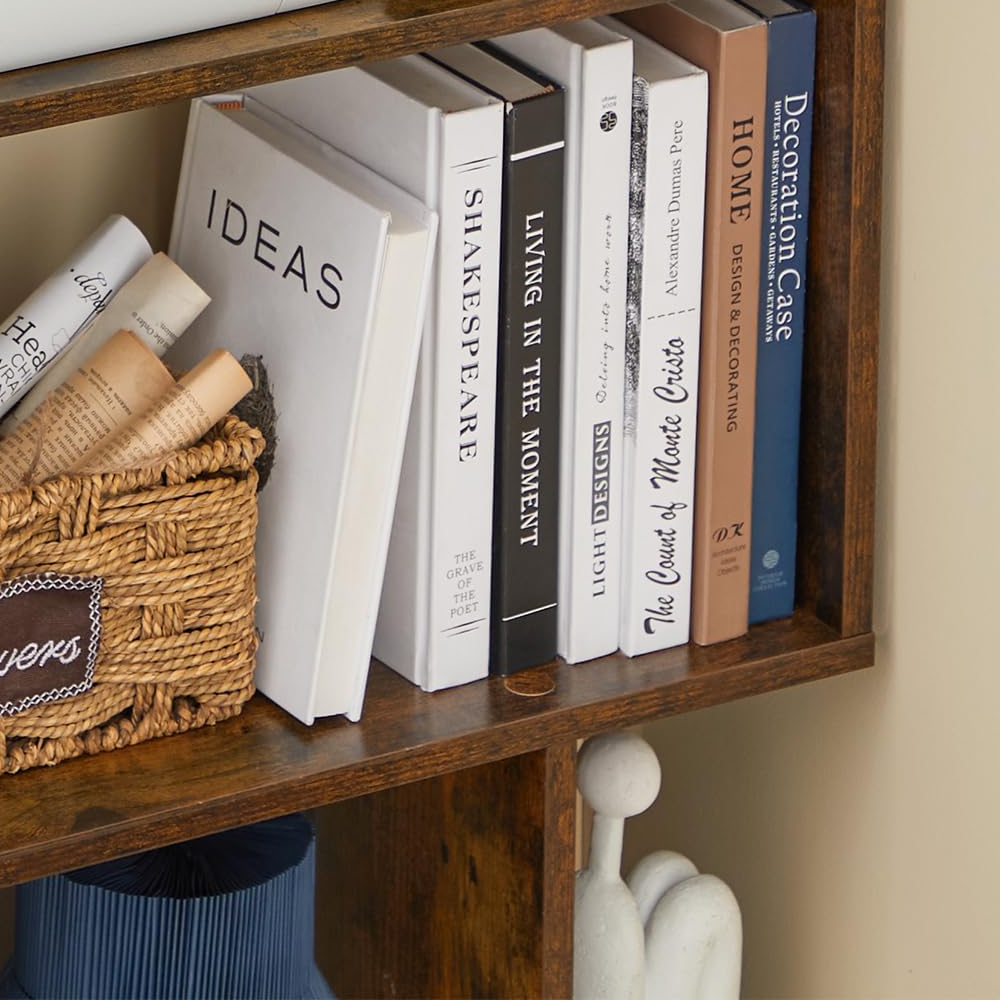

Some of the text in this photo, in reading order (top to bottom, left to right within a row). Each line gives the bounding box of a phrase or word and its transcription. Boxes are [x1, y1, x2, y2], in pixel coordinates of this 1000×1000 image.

[207, 189, 343, 310] IDEAS
[664, 119, 684, 297] Alexandre Dumas Pere
[726, 115, 754, 433] HOME DESIGN & DECORATING
[764, 100, 782, 343] HOTELS RESTAURANTS GARDENS GETAWAYS
[775, 91, 808, 341] Decoration Case
[134, 315, 155, 336] Order
[152, 332, 165, 345] the
[458, 188, 484, 463] SHAKESPEARE
[520, 211, 544, 547] LIVING IN THE MOMENT
[454, 550, 477, 562] THE
[593, 422, 611, 597] LIGHT DESIGNS
[644, 336, 689, 635] The Count of Monte Cristo
[446, 560, 484, 580] GRAVE
[450, 602, 479, 618] POET
[452, 590, 476, 604] THE
[457, 578, 472, 590] OF
